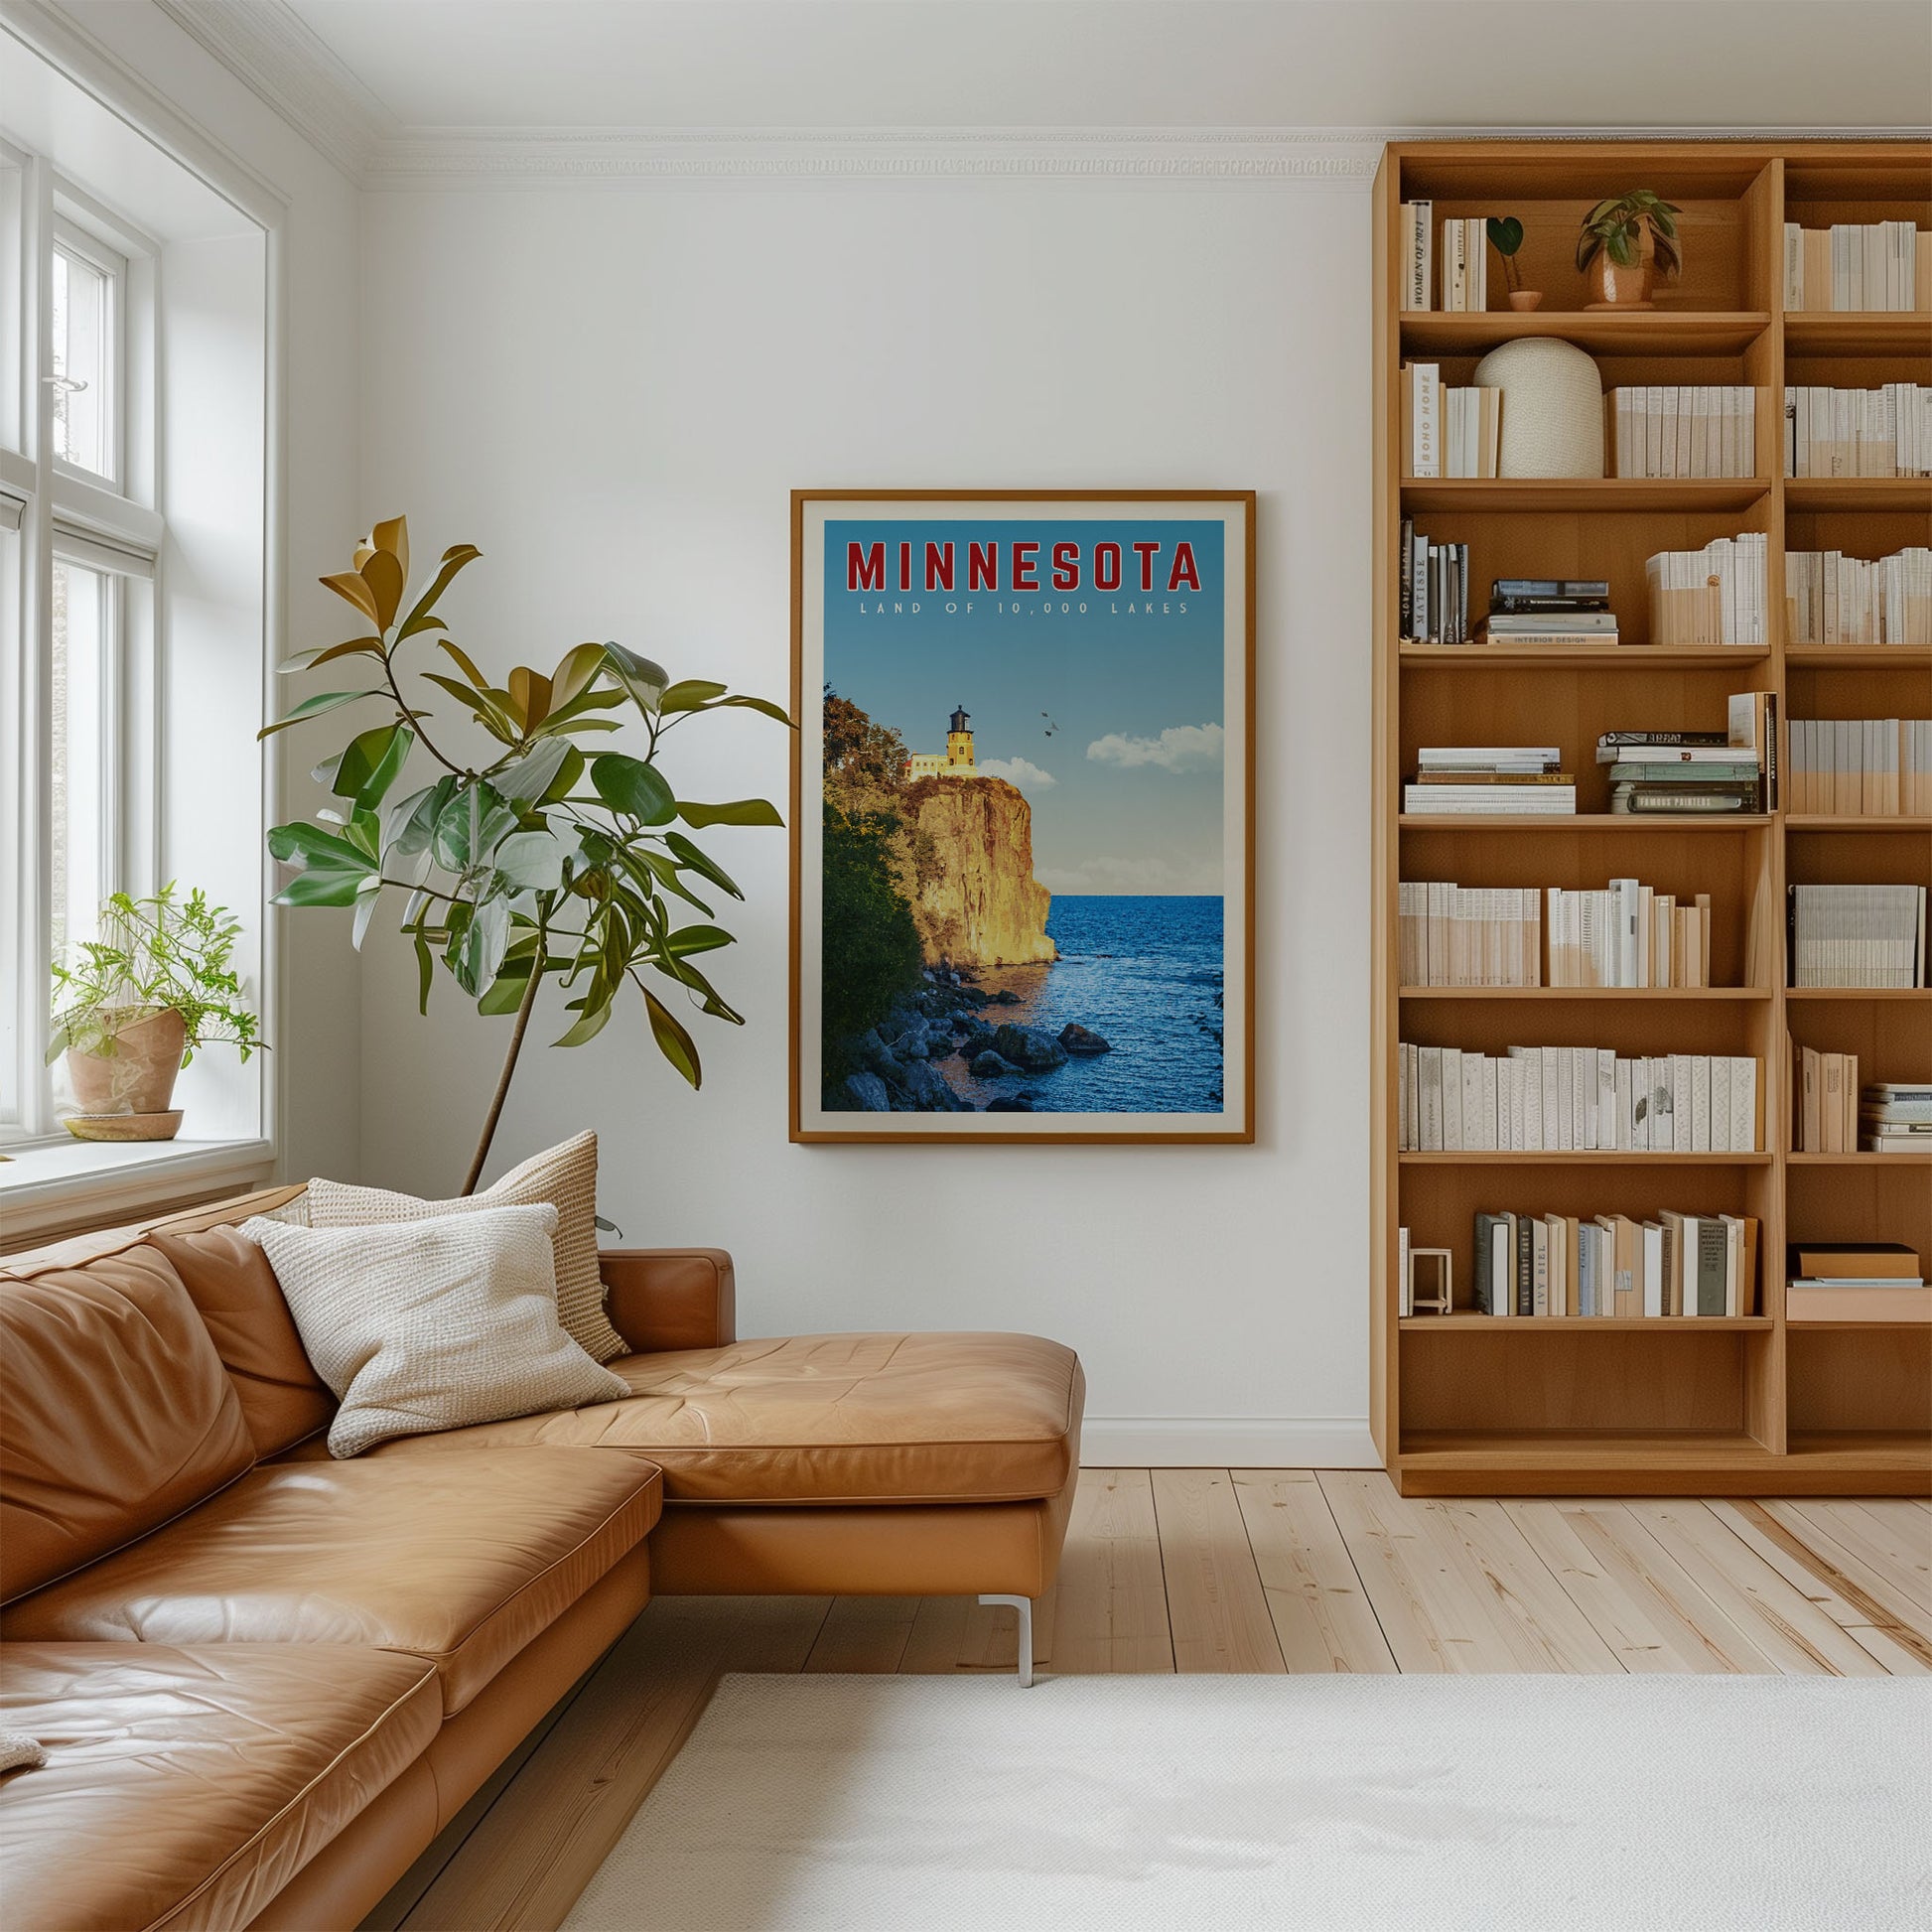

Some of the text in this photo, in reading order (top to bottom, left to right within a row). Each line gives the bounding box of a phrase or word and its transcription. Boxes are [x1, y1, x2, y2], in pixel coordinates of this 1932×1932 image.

[1415, 246, 1425, 260] OF
[1414, 263, 1425, 305] WOMEN
[1422, 374, 1431, 462] BOHO HOME
[847, 541, 1201, 592] MINNESOTA
[860, 602, 1187, 616] LAND OF 10,000 LAKES
[1416, 559, 1426, 624] MATISSE
[1639, 797, 1712, 807] FAMOUS PAINTERS
[1537, 1245, 1546, 1306] IVY BIEL
